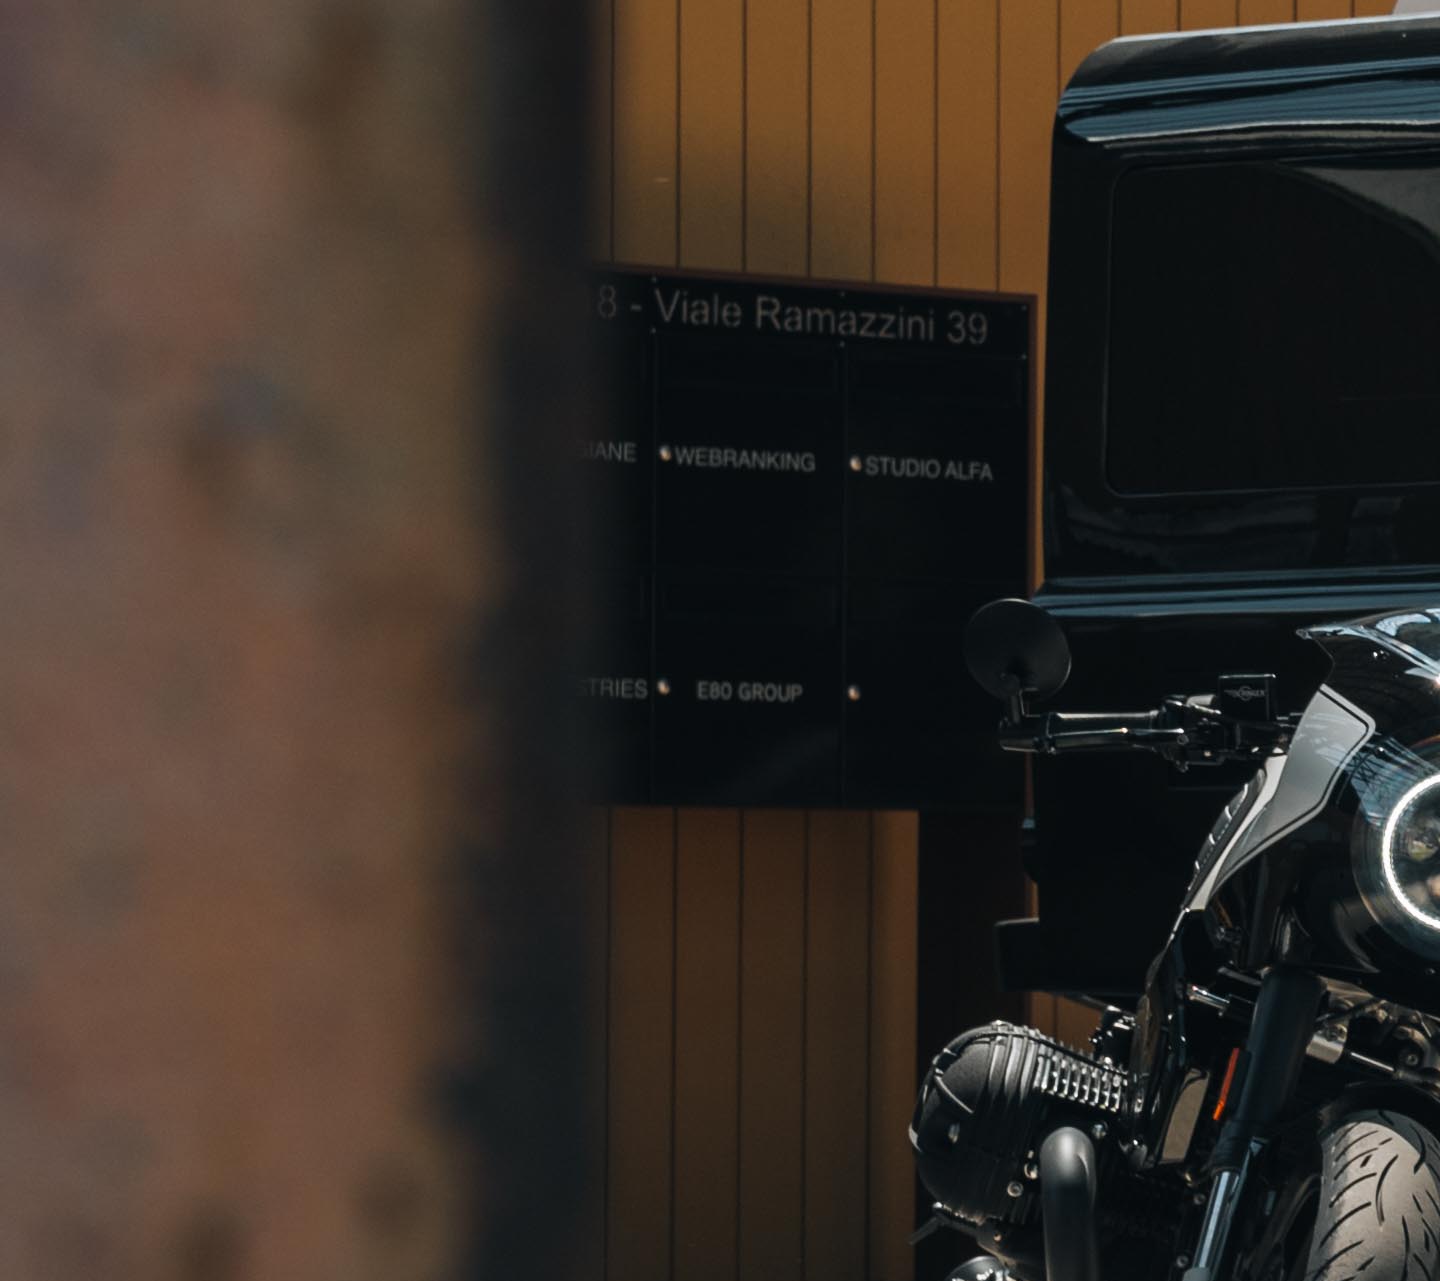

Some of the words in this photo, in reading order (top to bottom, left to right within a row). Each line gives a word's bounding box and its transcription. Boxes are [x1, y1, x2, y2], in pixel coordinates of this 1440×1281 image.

[653, 287, 743, 328] Viale
[755, 295, 936, 342] Ramazzini
[946, 310, 989, 345] 39
[674, 445, 816, 473] WEBRANKING
[865, 456, 942, 480] STUDIO
[944, 459, 994, 481] ALFA
[697, 680, 733, 701] E80
[737, 681, 803, 703] GROUP
